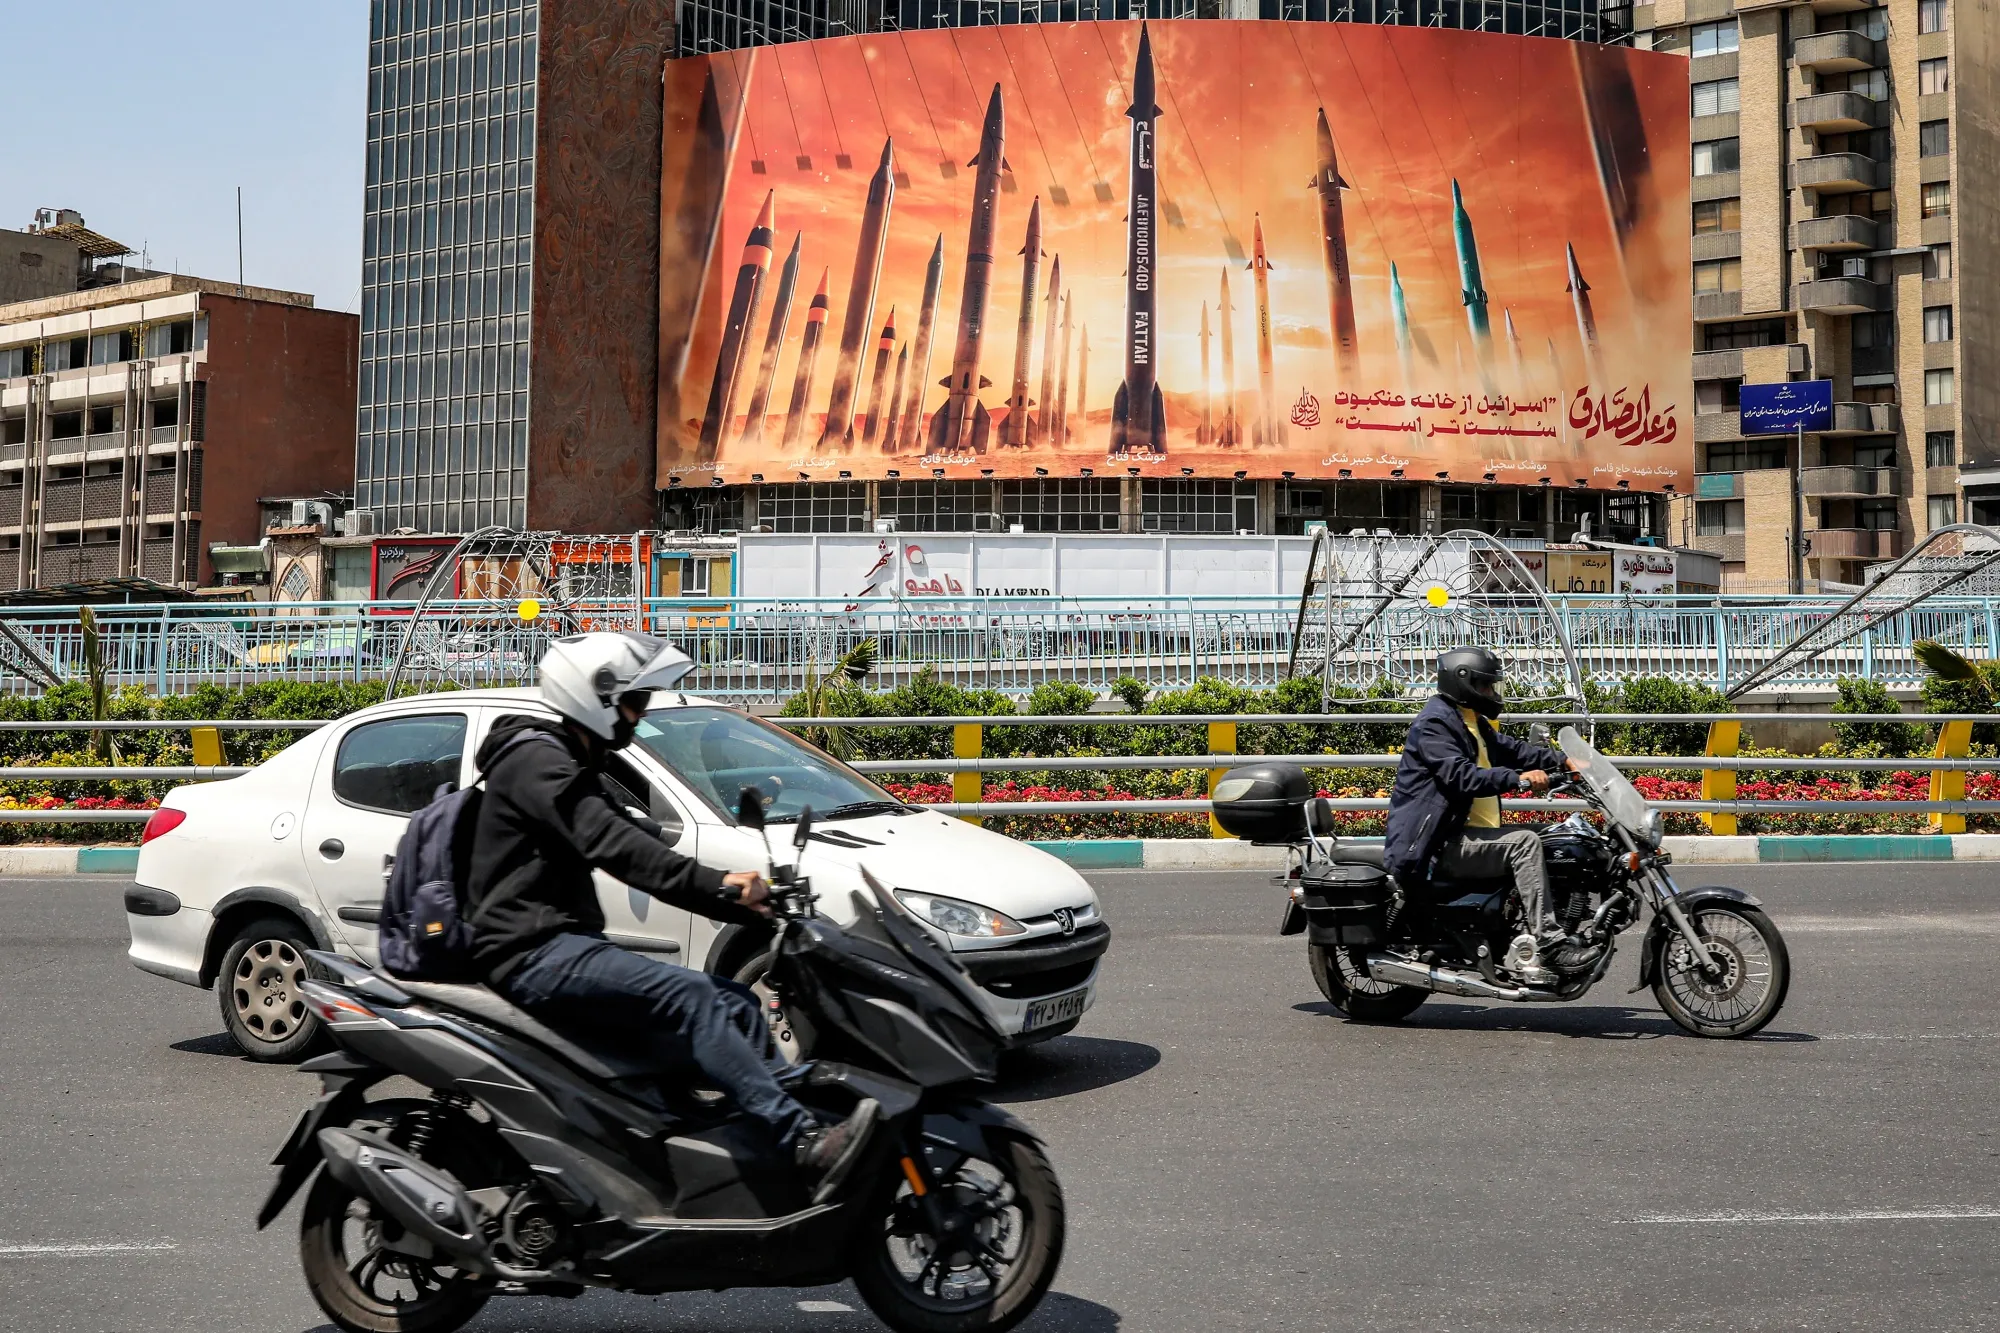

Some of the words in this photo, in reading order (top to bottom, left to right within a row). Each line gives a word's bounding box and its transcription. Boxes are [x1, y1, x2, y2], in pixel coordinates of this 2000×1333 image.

[1134, 312, 1149, 364] FATTAH
[1334, 390, 1406, 411] عنکبوت
[1411, 393, 1457, 409] خانه
[1459, 395, 1472, 415] از
[1427, 419, 1460, 437] تر
[787, 457, 804, 470] قدر
[805, 458, 836, 469] موشک
[920, 453, 941, 468] فاتح
[943, 453, 976, 468] موشک
[1106, 451, 1129, 466] فتاح
[1131, 451, 1167, 465] موشک
[1376, 454, 1410, 469] موشک
[1485, 458, 1516, 472] سجیل
[666, 463, 697, 476] خرمشهر
[698, 462, 725, 473] موشک
[1517, 459, 1547, 473] موشک
[1593, 462, 1614, 476] قاسم
[1615, 463, 1631, 477] حاج
[1631, 466, 1653, 476] شهید
[1653, 465, 1678, 478] موشک
[1581, 559, 1607, 570] فروشگاه
[1623, 554, 1646, 577] فود
[1647, 555, 1674, 576] فست
